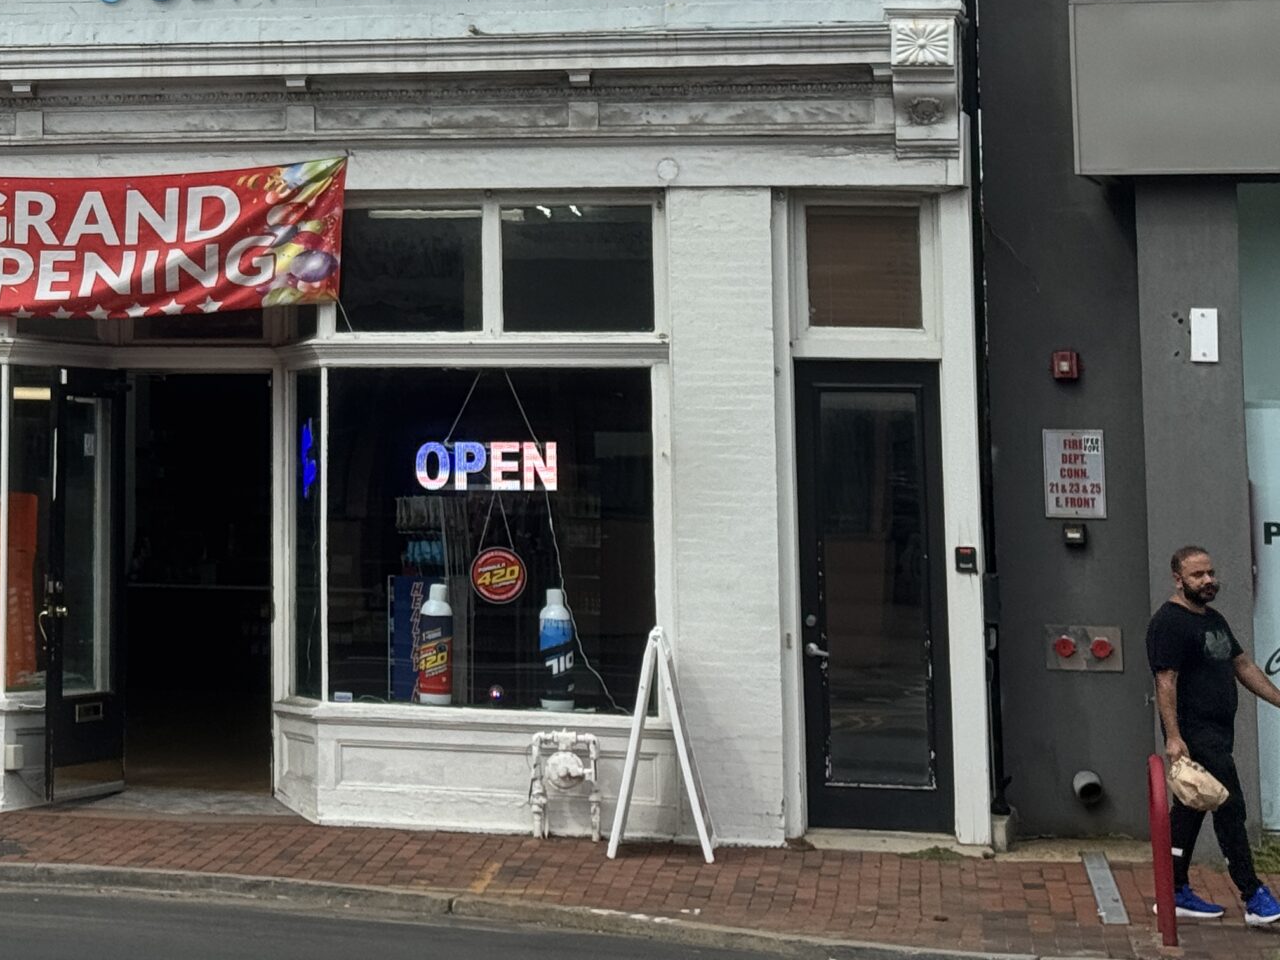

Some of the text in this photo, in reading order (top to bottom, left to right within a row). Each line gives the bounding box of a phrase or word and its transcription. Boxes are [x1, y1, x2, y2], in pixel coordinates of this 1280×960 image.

[415, 441, 548, 491] OPEN
[1061, 453, 1088, 465] DEPT.
[1060, 467, 1090, 480] CONN.
[1049, 482, 1102, 495] 21 & 23 & 25
[1065, 497, 1096, 509] FRONT
[477, 565, 520, 586] 420
[419, 652, 448, 671] 420
[545, 651, 574, 675] 710
